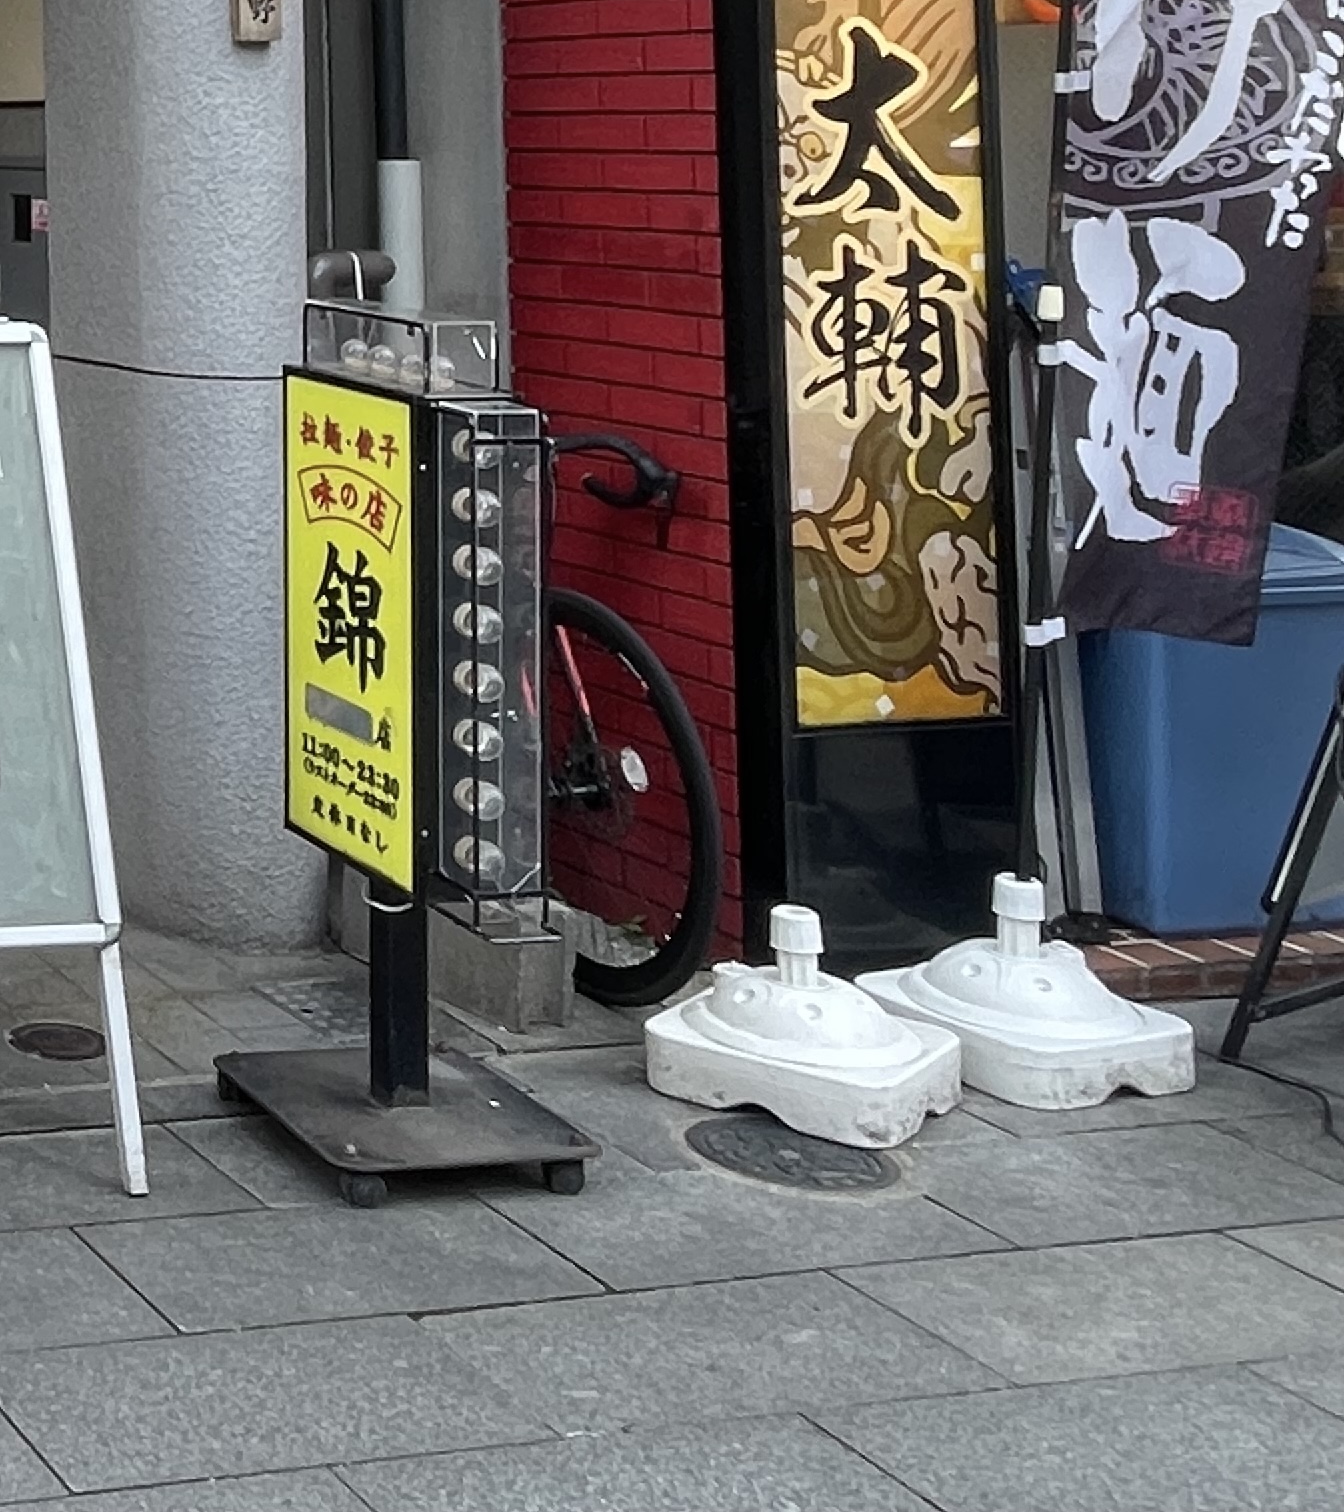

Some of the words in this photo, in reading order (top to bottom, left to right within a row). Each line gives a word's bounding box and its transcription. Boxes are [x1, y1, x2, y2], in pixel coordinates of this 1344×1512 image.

[309, 472, 388, 534] 味の店
[313, 540, 386, 694] 錦
